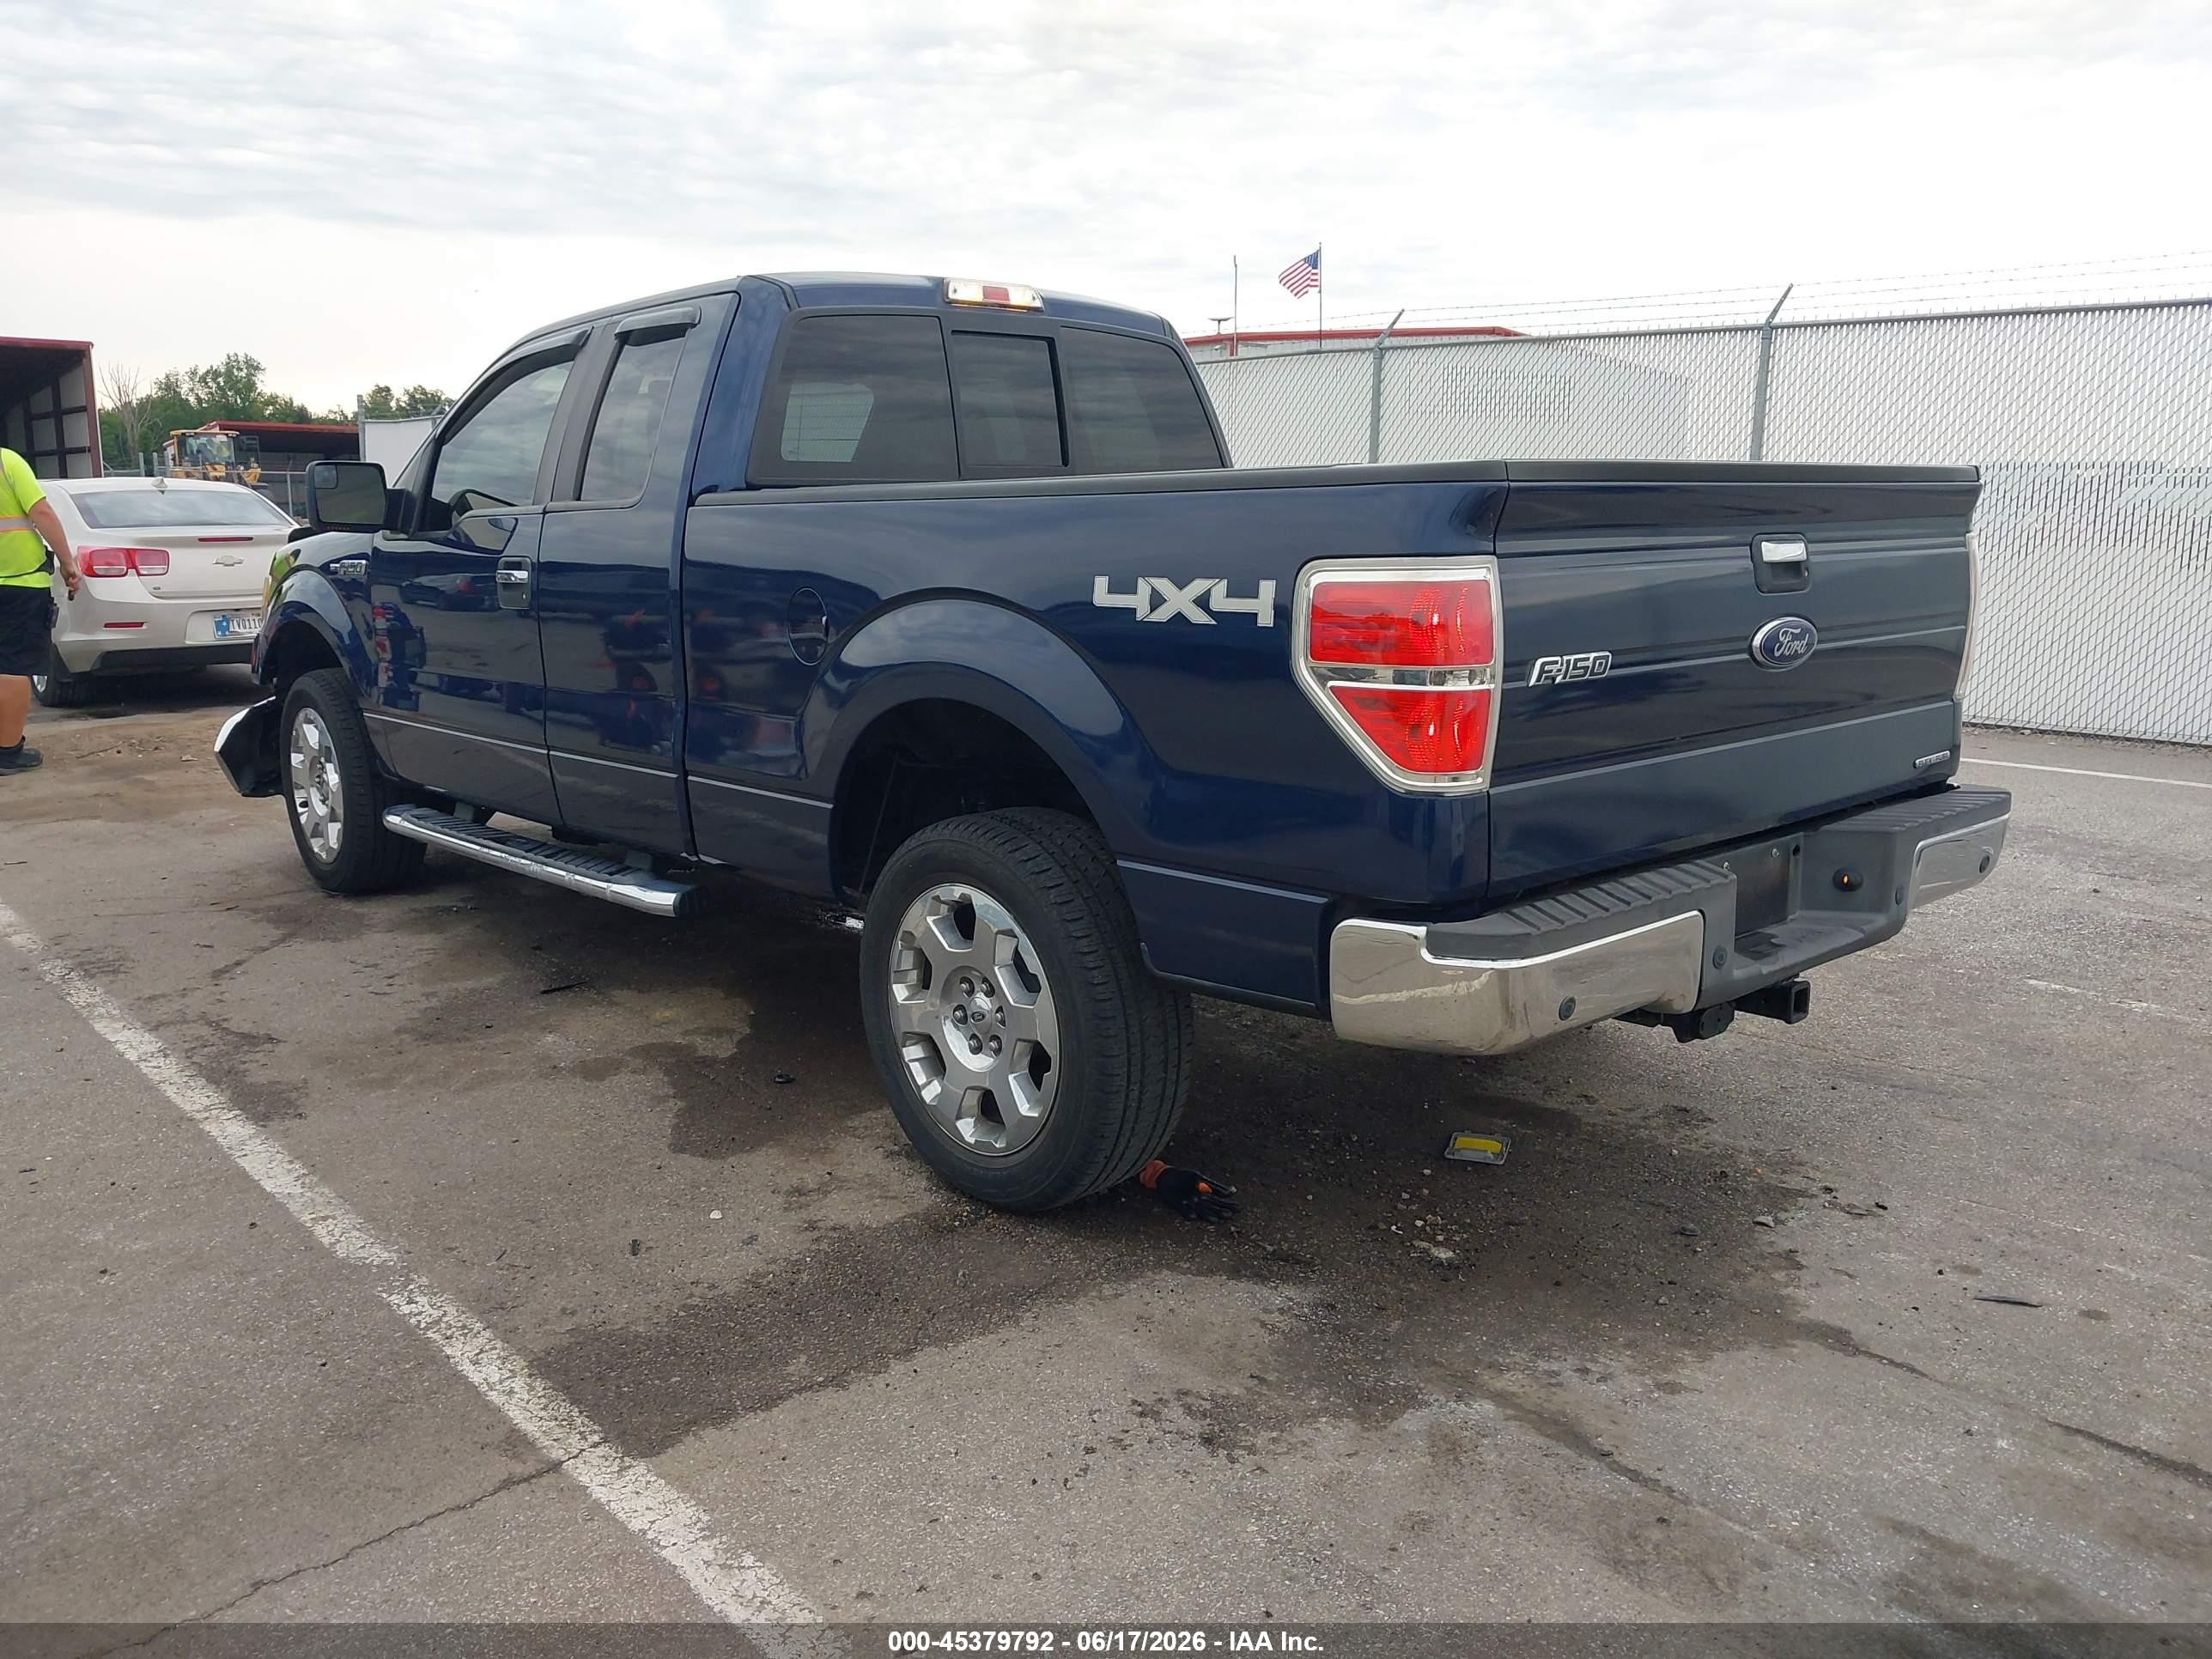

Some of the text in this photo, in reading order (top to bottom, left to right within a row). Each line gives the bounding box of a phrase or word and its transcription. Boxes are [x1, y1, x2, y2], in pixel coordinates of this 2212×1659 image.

[1092, 574, 1277, 628] 4X4
[1773, 628, 1809, 658] Ford
[1528, 651, 1613, 688] F-150
